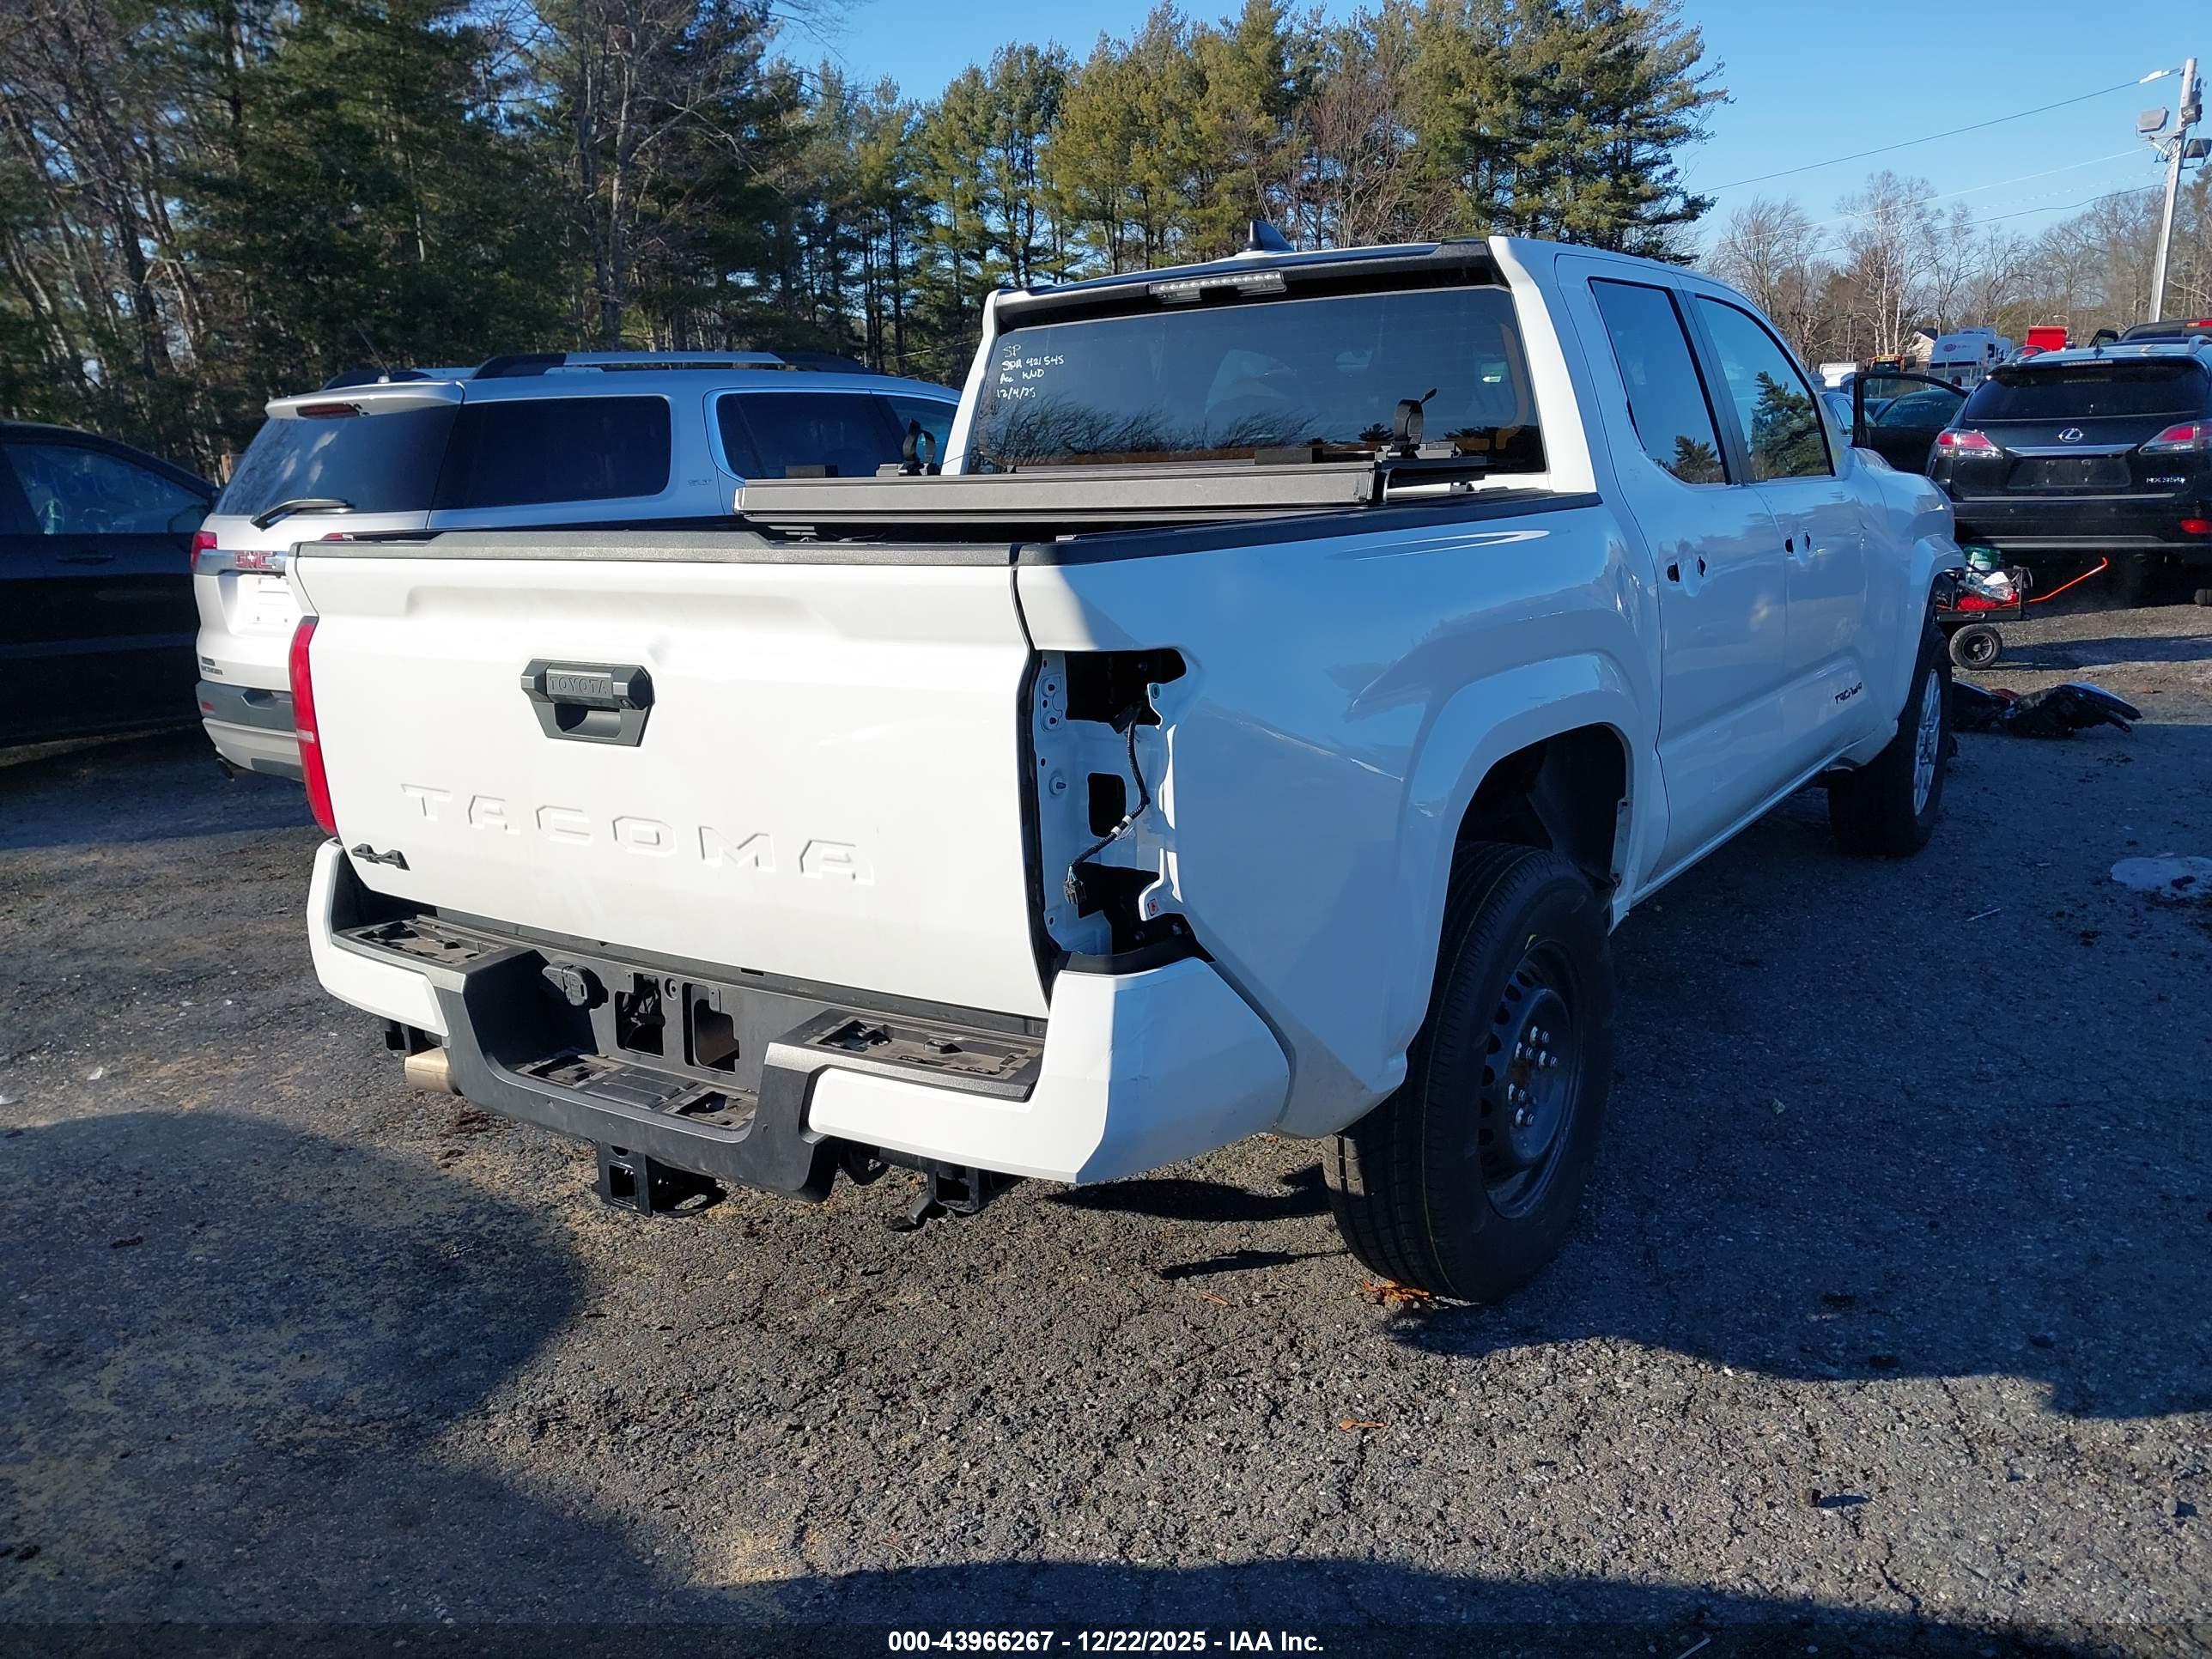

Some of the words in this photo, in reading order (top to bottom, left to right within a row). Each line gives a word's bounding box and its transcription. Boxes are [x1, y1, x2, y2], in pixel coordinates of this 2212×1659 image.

[1002, 344, 1021, 357] SP
[233, 550, 276, 570] GMC
[550, 676, 608, 695] TOYOTA
[402, 783, 875, 885] TACOMA
